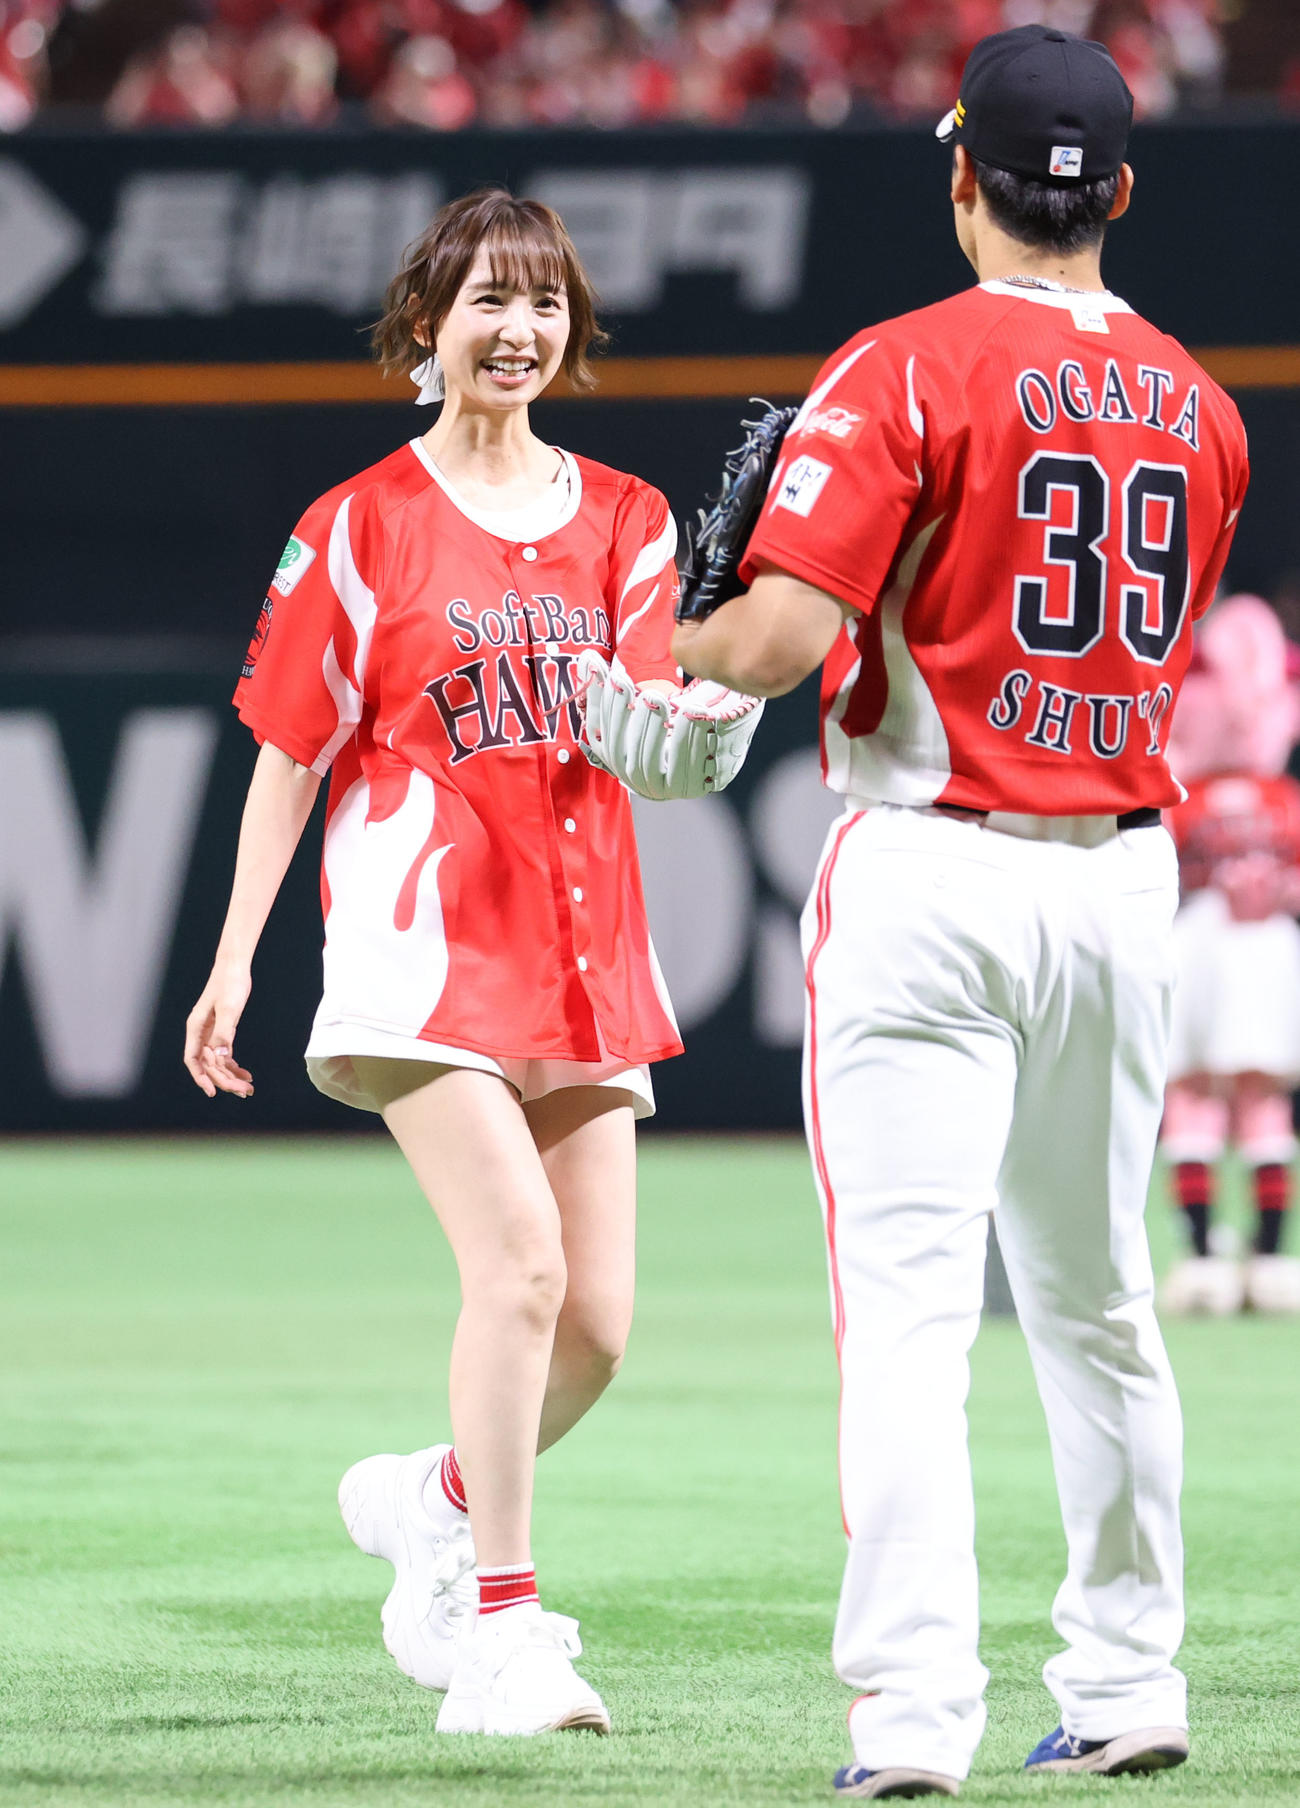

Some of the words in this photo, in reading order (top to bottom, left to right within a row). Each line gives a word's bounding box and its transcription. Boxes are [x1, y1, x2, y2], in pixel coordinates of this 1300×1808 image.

[1015, 358, 1200, 453] OGATA
[1011, 449, 1191, 667] 39
[446, 590, 613, 653] SoftBan
[422, 651, 585, 767] HAW
